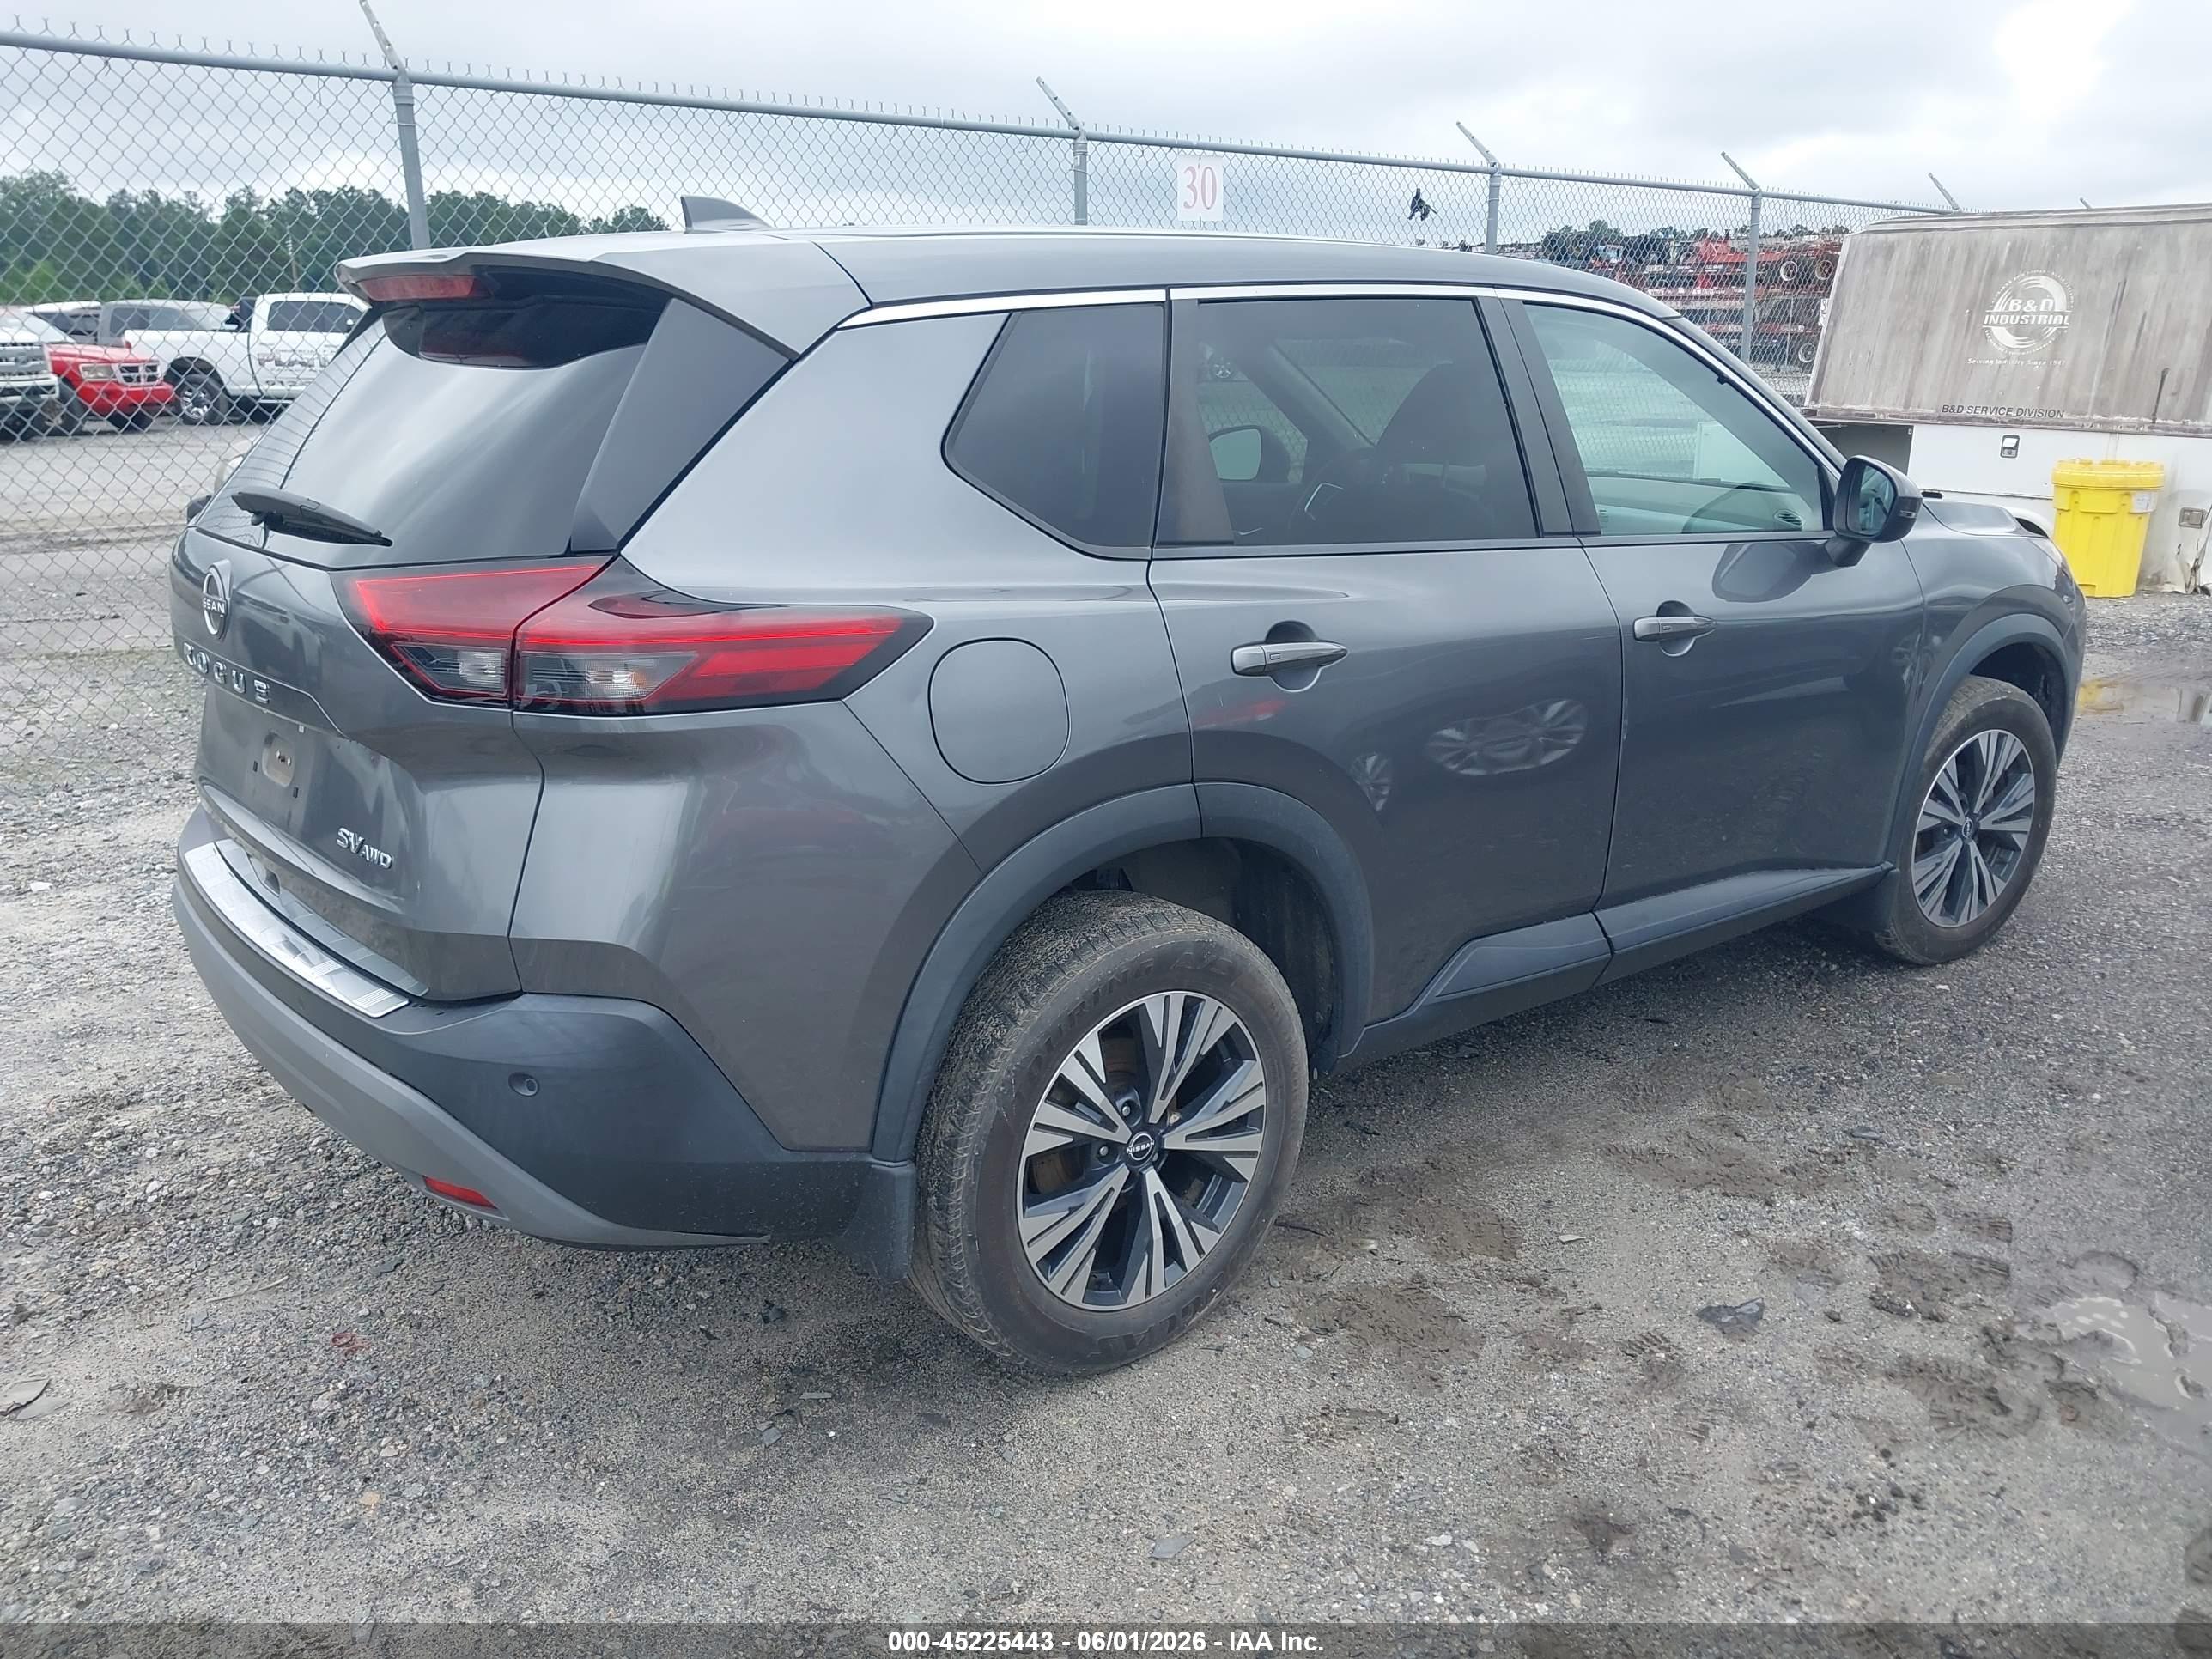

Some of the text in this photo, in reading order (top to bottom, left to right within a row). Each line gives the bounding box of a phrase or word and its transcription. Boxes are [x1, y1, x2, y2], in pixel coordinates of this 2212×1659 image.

[1183, 166, 1217, 210] 30
[2008, 298, 2055, 312] B&D
[1984, 314, 2070, 325] INDUSTRIAL
[1942, 404, 2065, 419] B&D SERVICE DIVISION
[183, 641, 270, 705] ROGUE
[336, 827, 393, 870] SV AWD
[1126, 1139, 1155, 1154] NISSAN
